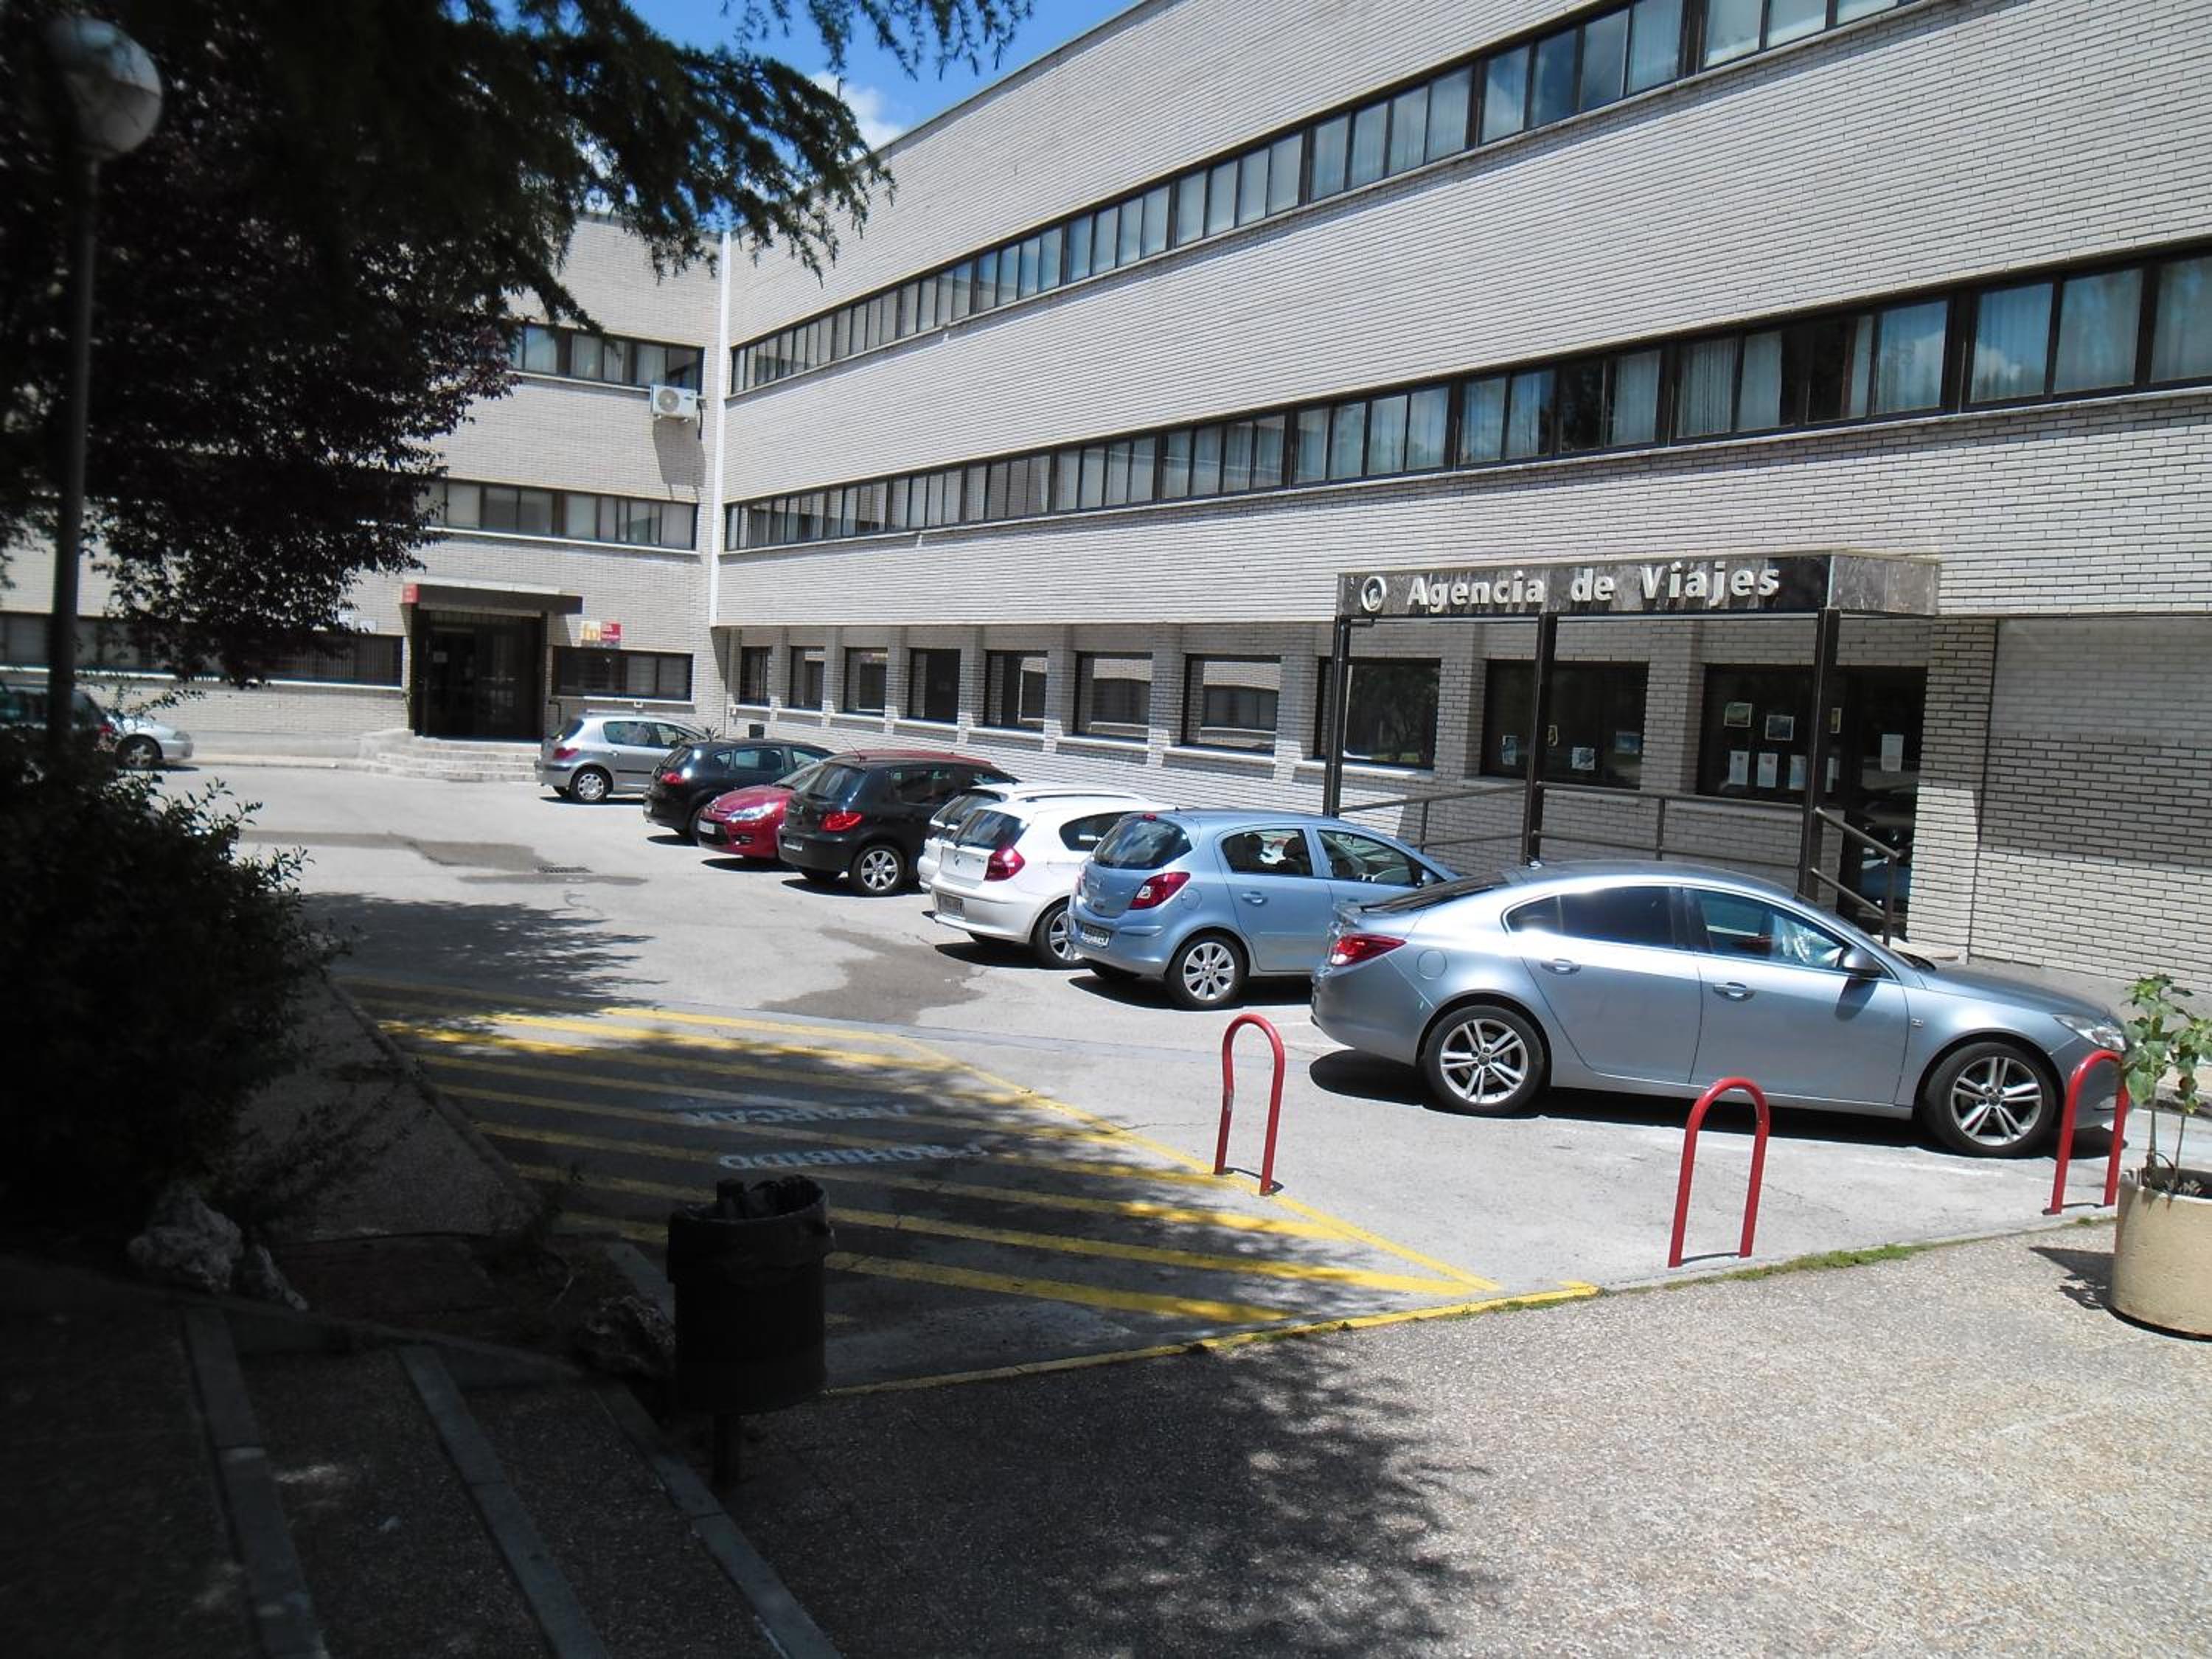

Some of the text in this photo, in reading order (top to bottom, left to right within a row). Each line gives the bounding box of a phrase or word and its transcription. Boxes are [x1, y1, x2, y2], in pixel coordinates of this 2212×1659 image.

[1407, 561, 1781, 613] Agencia de Viajes
